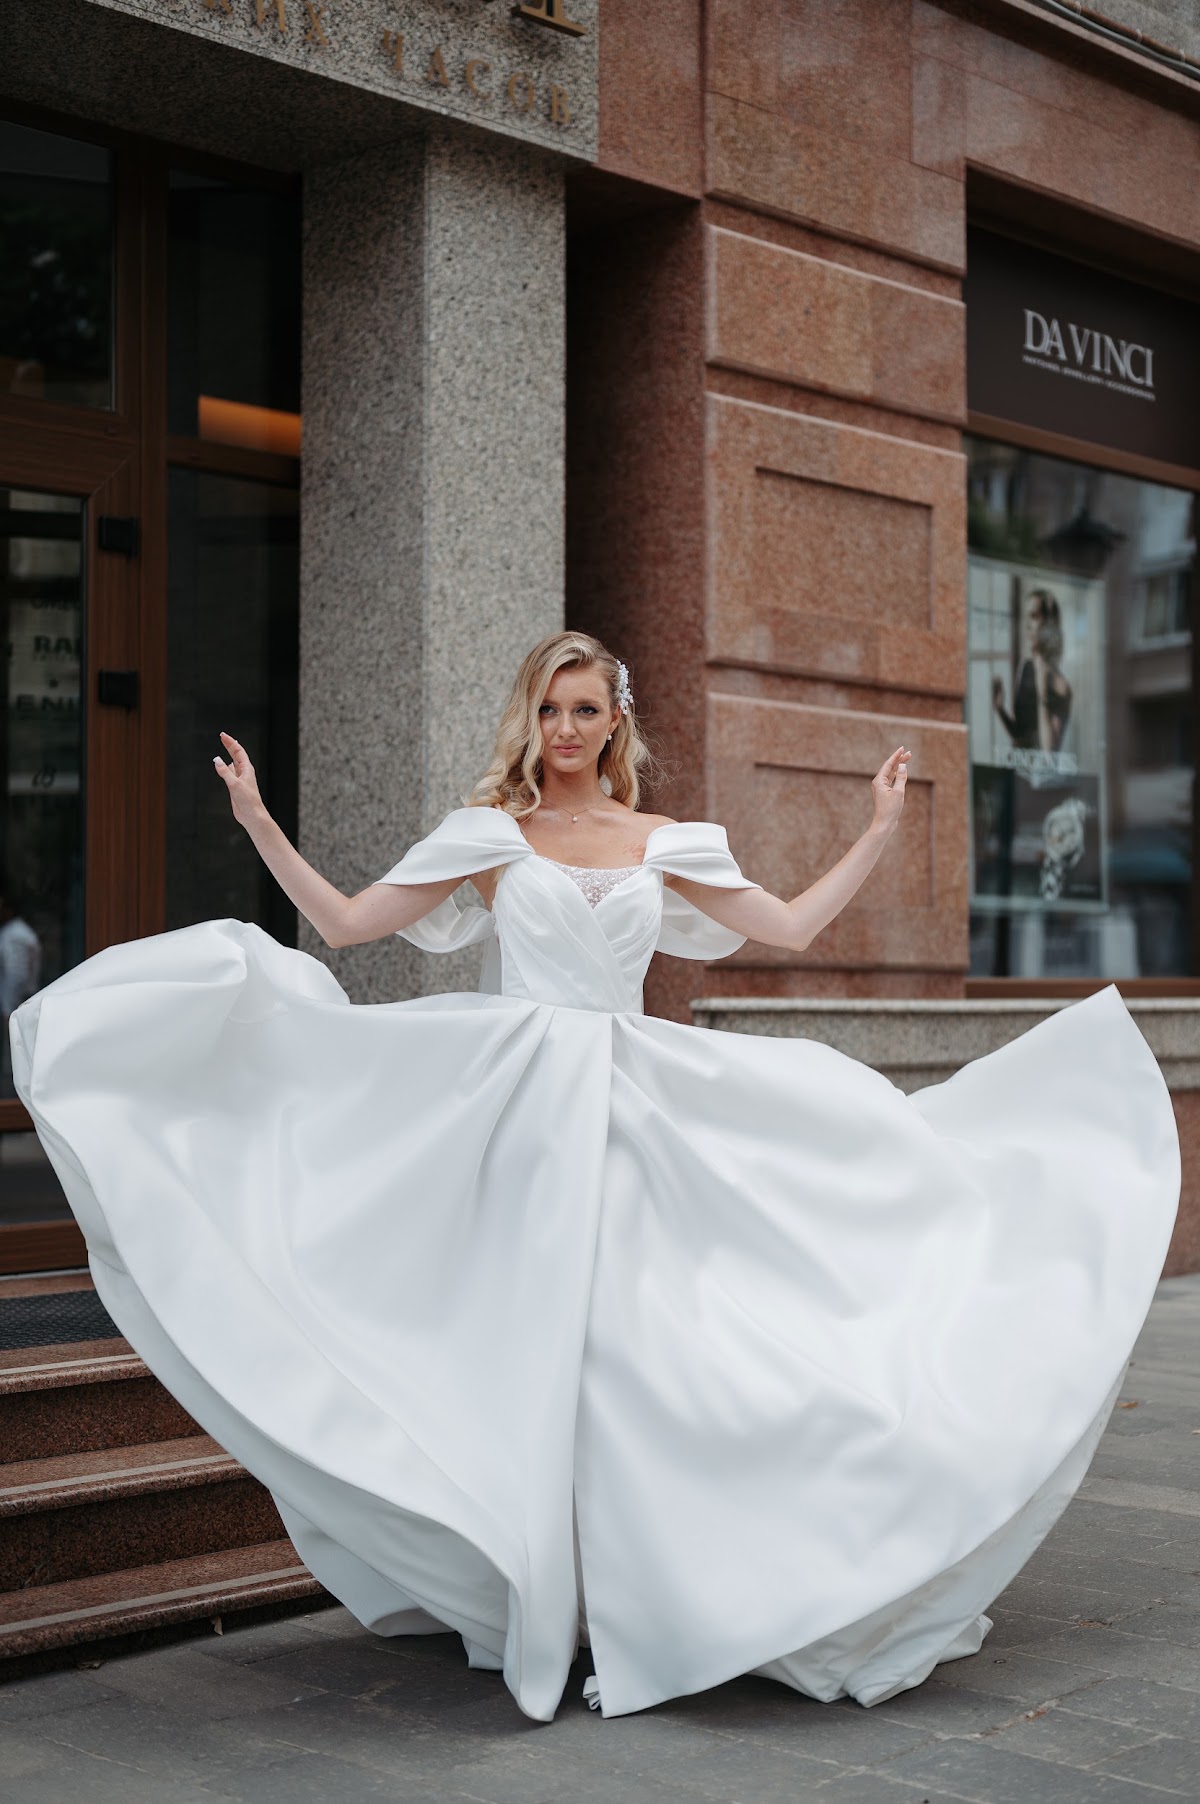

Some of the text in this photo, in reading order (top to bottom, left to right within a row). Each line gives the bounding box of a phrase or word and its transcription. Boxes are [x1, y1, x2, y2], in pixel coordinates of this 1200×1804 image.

[382, 28, 572, 124] ЧАСОВ
[1023, 309, 1067, 360] DA
[1069, 323, 1154, 387] VINCI
